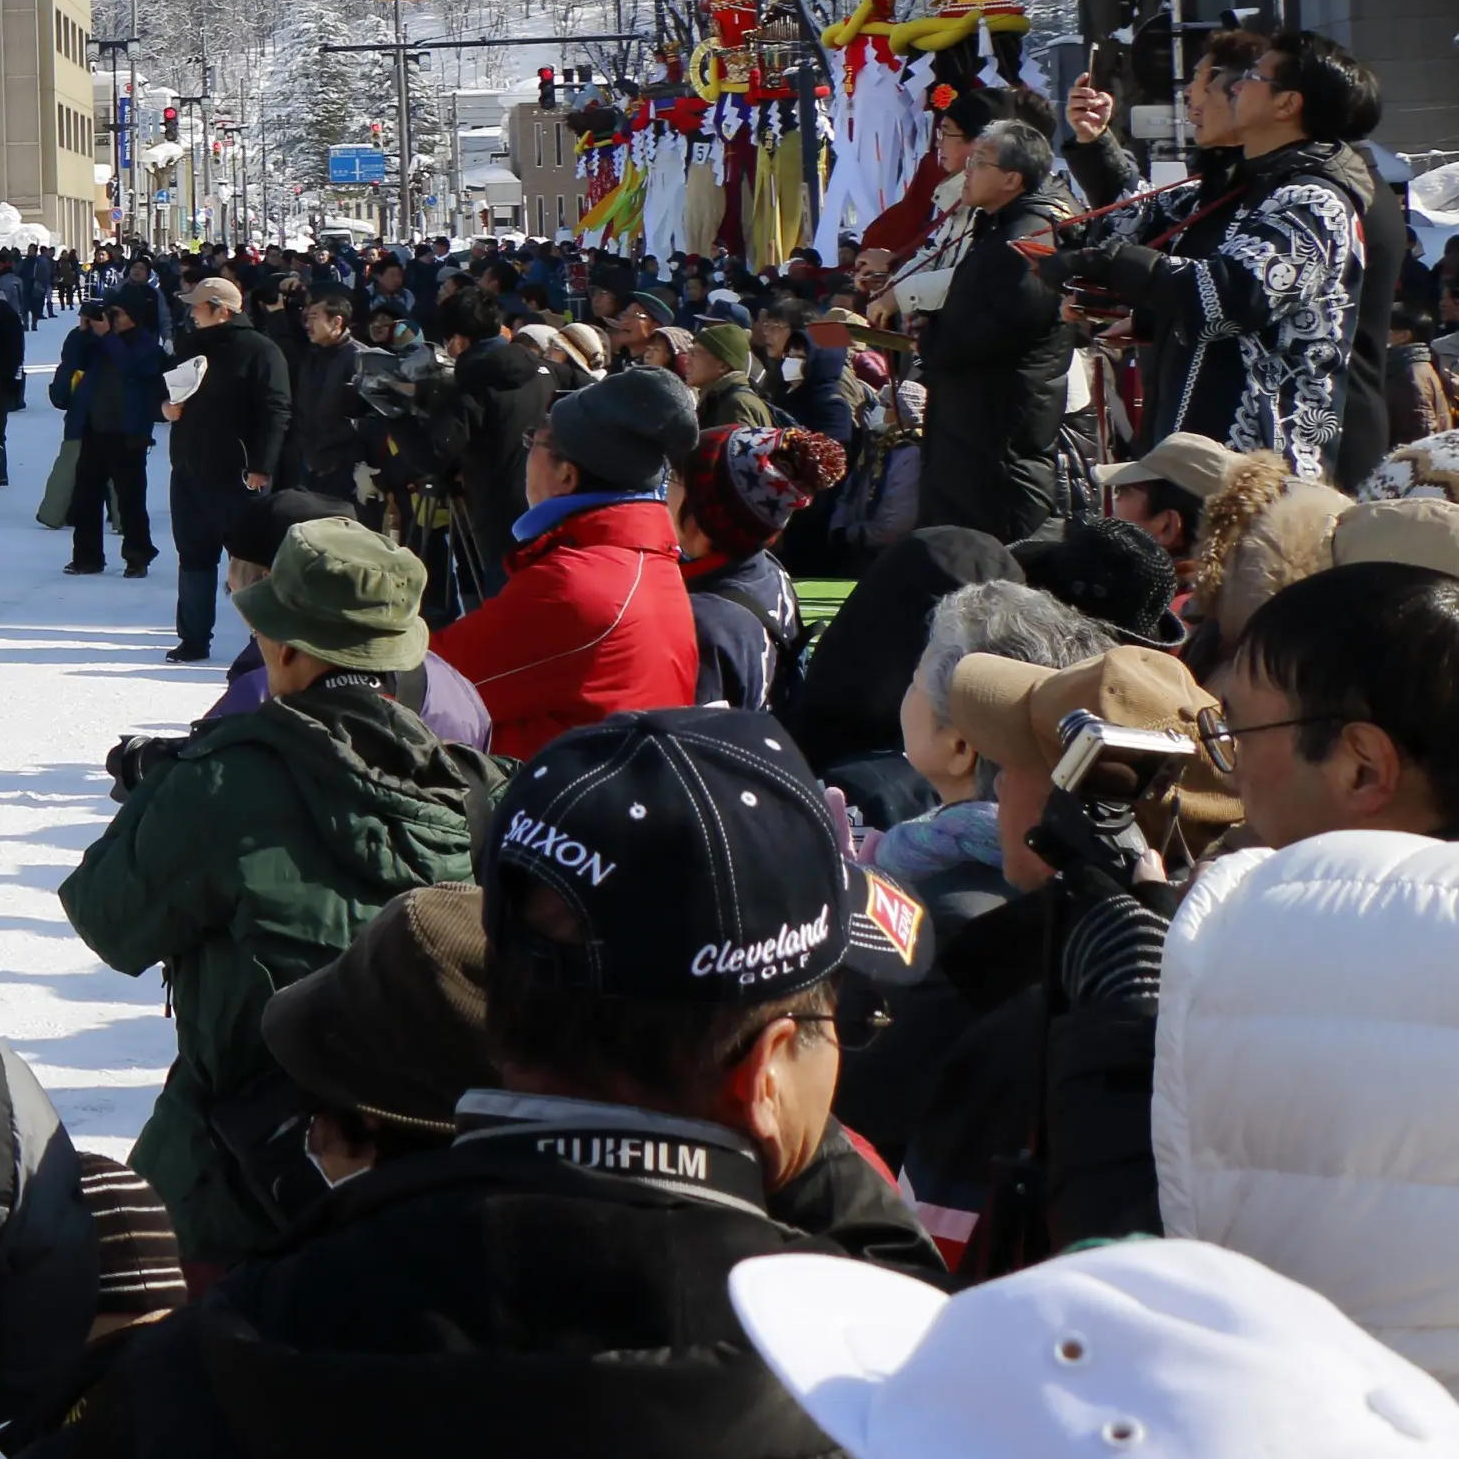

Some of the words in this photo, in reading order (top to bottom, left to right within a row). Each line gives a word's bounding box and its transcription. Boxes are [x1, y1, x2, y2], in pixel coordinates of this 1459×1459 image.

[325, 673, 382, 689] Canon
[501, 808, 617, 888] SRIXON
[873, 882, 902, 935] Z
[897, 907, 914, 946] STAR
[690, 903, 830, 978] Cleveland
[738, 951, 812, 985] GOLF
